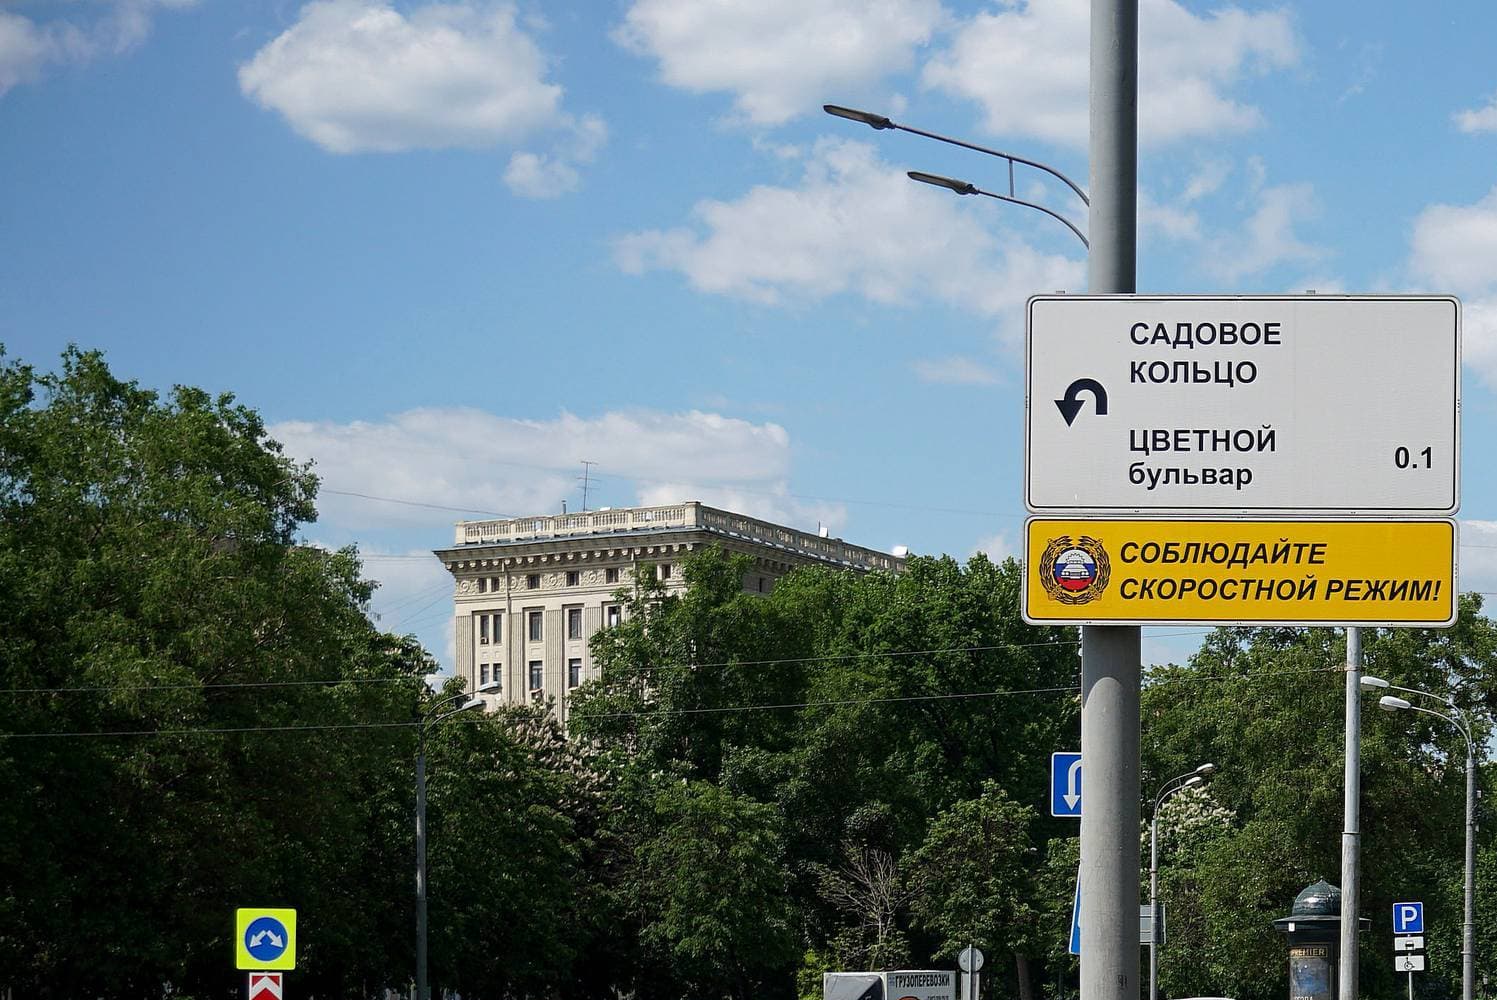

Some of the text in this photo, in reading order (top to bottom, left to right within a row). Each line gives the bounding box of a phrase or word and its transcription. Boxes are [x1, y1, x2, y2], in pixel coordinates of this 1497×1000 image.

[1129, 322, 1282, 349] САДОВОЕ
[1129, 360, 1258, 387] КОЛЬЦО
[1129, 424, 1277, 456] ЦВЕТНОЙ
[1394, 446, 1434, 470] 0.1
[1128, 462, 1253, 490] бульвар
[1119, 538, 1327, 568] СОБЛЮДАЙТЕ
[1119, 574, 1442, 601] СКОРОСТНОЙ РЕЖИМ!
[1401, 906, 1418, 930] P
[895, 974, 950, 988] ГРУЗОПЕРЕВОЗКИ
